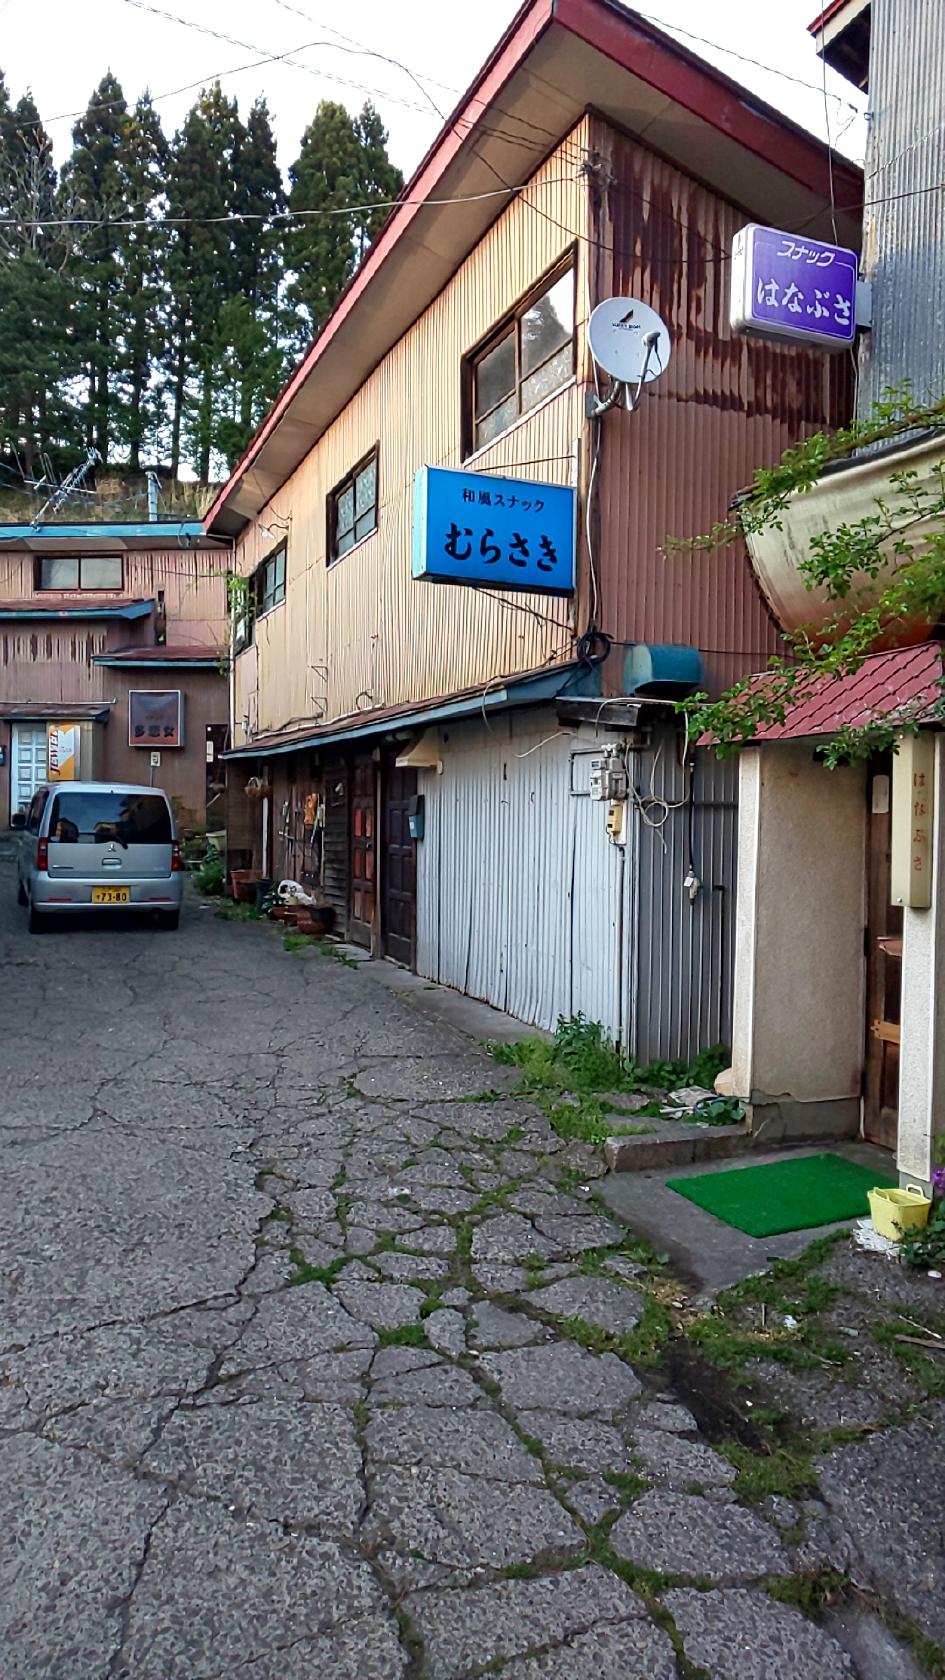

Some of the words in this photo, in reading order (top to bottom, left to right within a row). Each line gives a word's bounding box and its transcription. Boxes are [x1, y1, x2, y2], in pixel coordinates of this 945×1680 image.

[776, 240, 836, 267] スナック
[757, 277, 851, 325] はなぶさ
[462, 487, 545, 513] 和風スナック
[444, 522, 558, 572] むらさき
[50, 729, 61, 777] JEWEL
